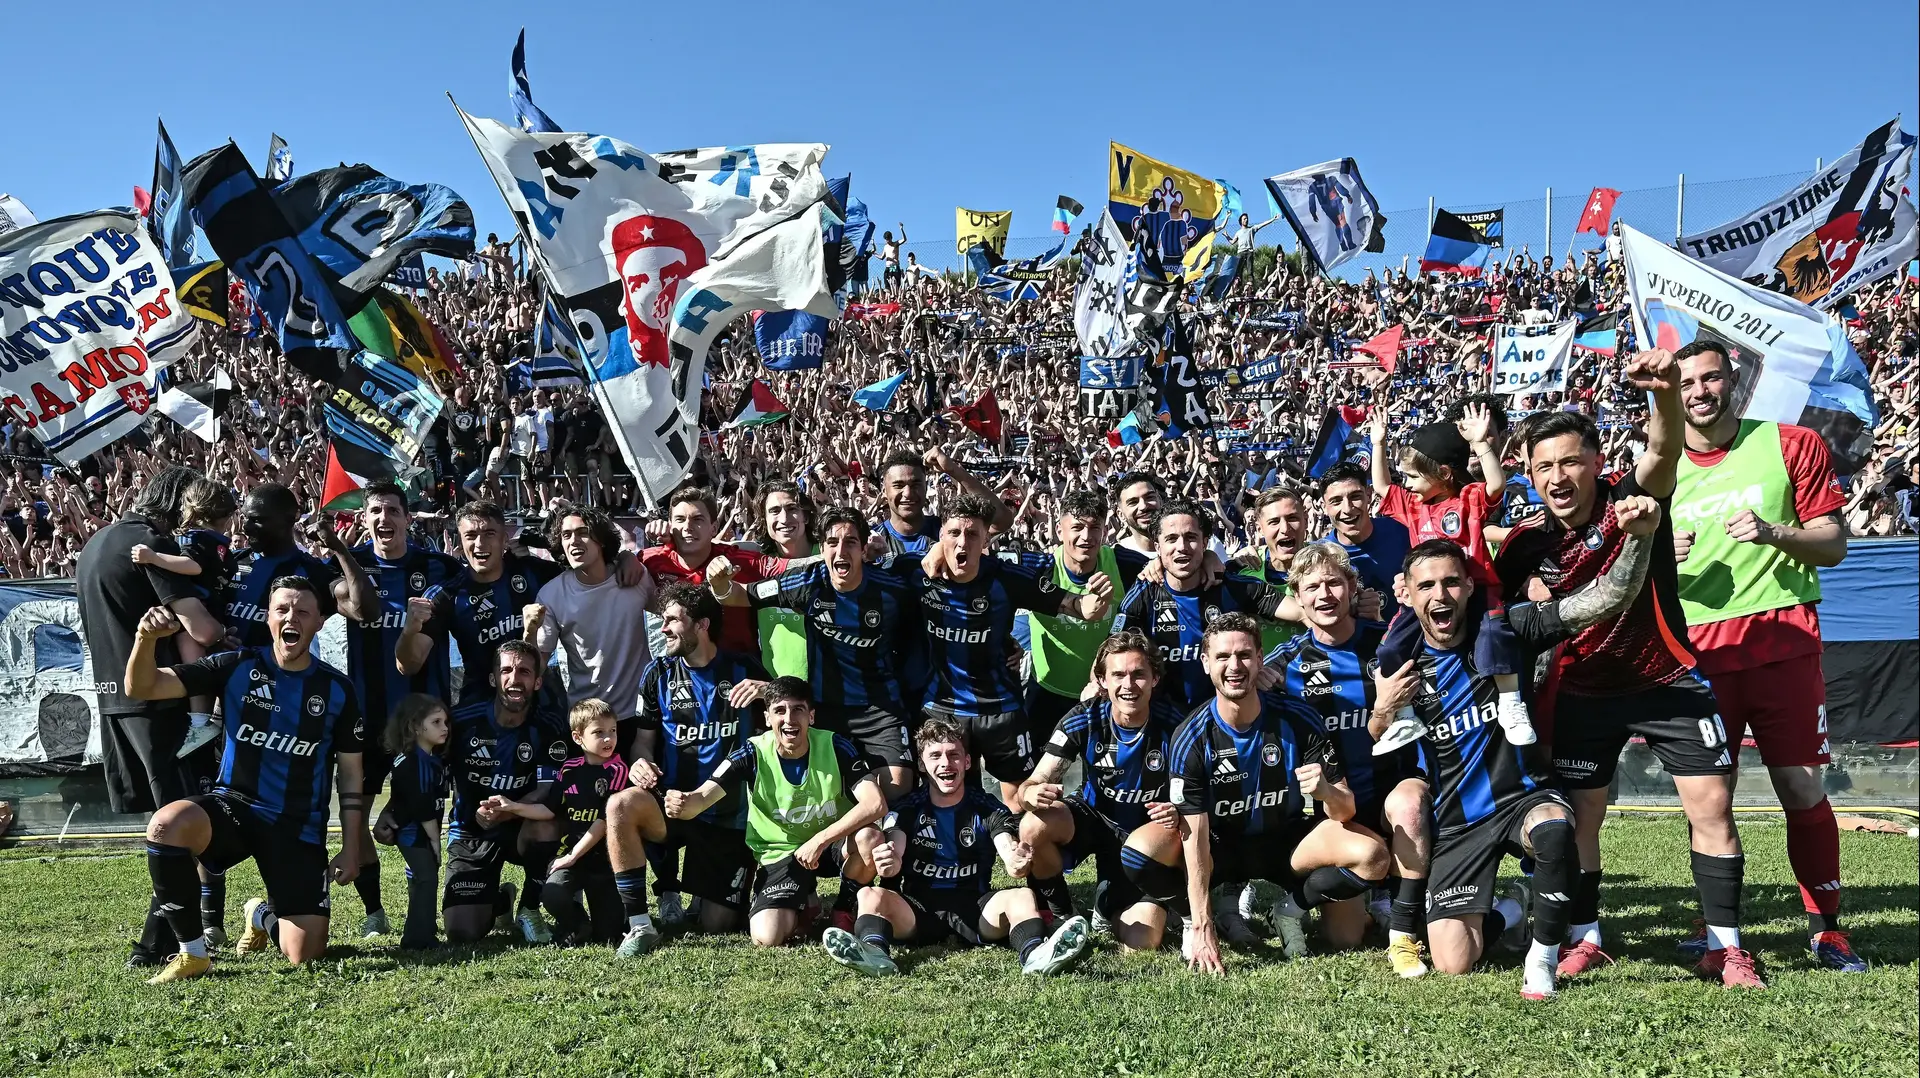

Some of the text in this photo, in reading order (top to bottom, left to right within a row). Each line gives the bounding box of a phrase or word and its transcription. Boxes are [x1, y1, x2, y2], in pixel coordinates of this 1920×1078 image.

[1457, 213, 1497, 223] ALDERA
[1686, 167, 1845, 259] TRADIZIONE
[0, 228, 141, 310] NQUE
[387, 266, 423, 284] STO
[1733, 312, 1785, 347] 2011
[1243, 361, 1277, 380] Clan
[225, 602, 269, 622] etila
[359, 611, 406, 629] etil
[478, 615, 525, 645] Cetila
[927, 619, 991, 643] Cetilar
[1158, 643, 1199, 662] Ceti
[675, 718, 738, 741] Cetilar
[1320, 708, 1374, 732] etil
[1428, 701, 1498, 741] etila
[236, 723, 321, 756] Cetilar
[1572, 760, 1598, 771] LUIGI
[567, 807, 598, 822] Cetil
[1453, 885, 1478, 894] LUIGI
